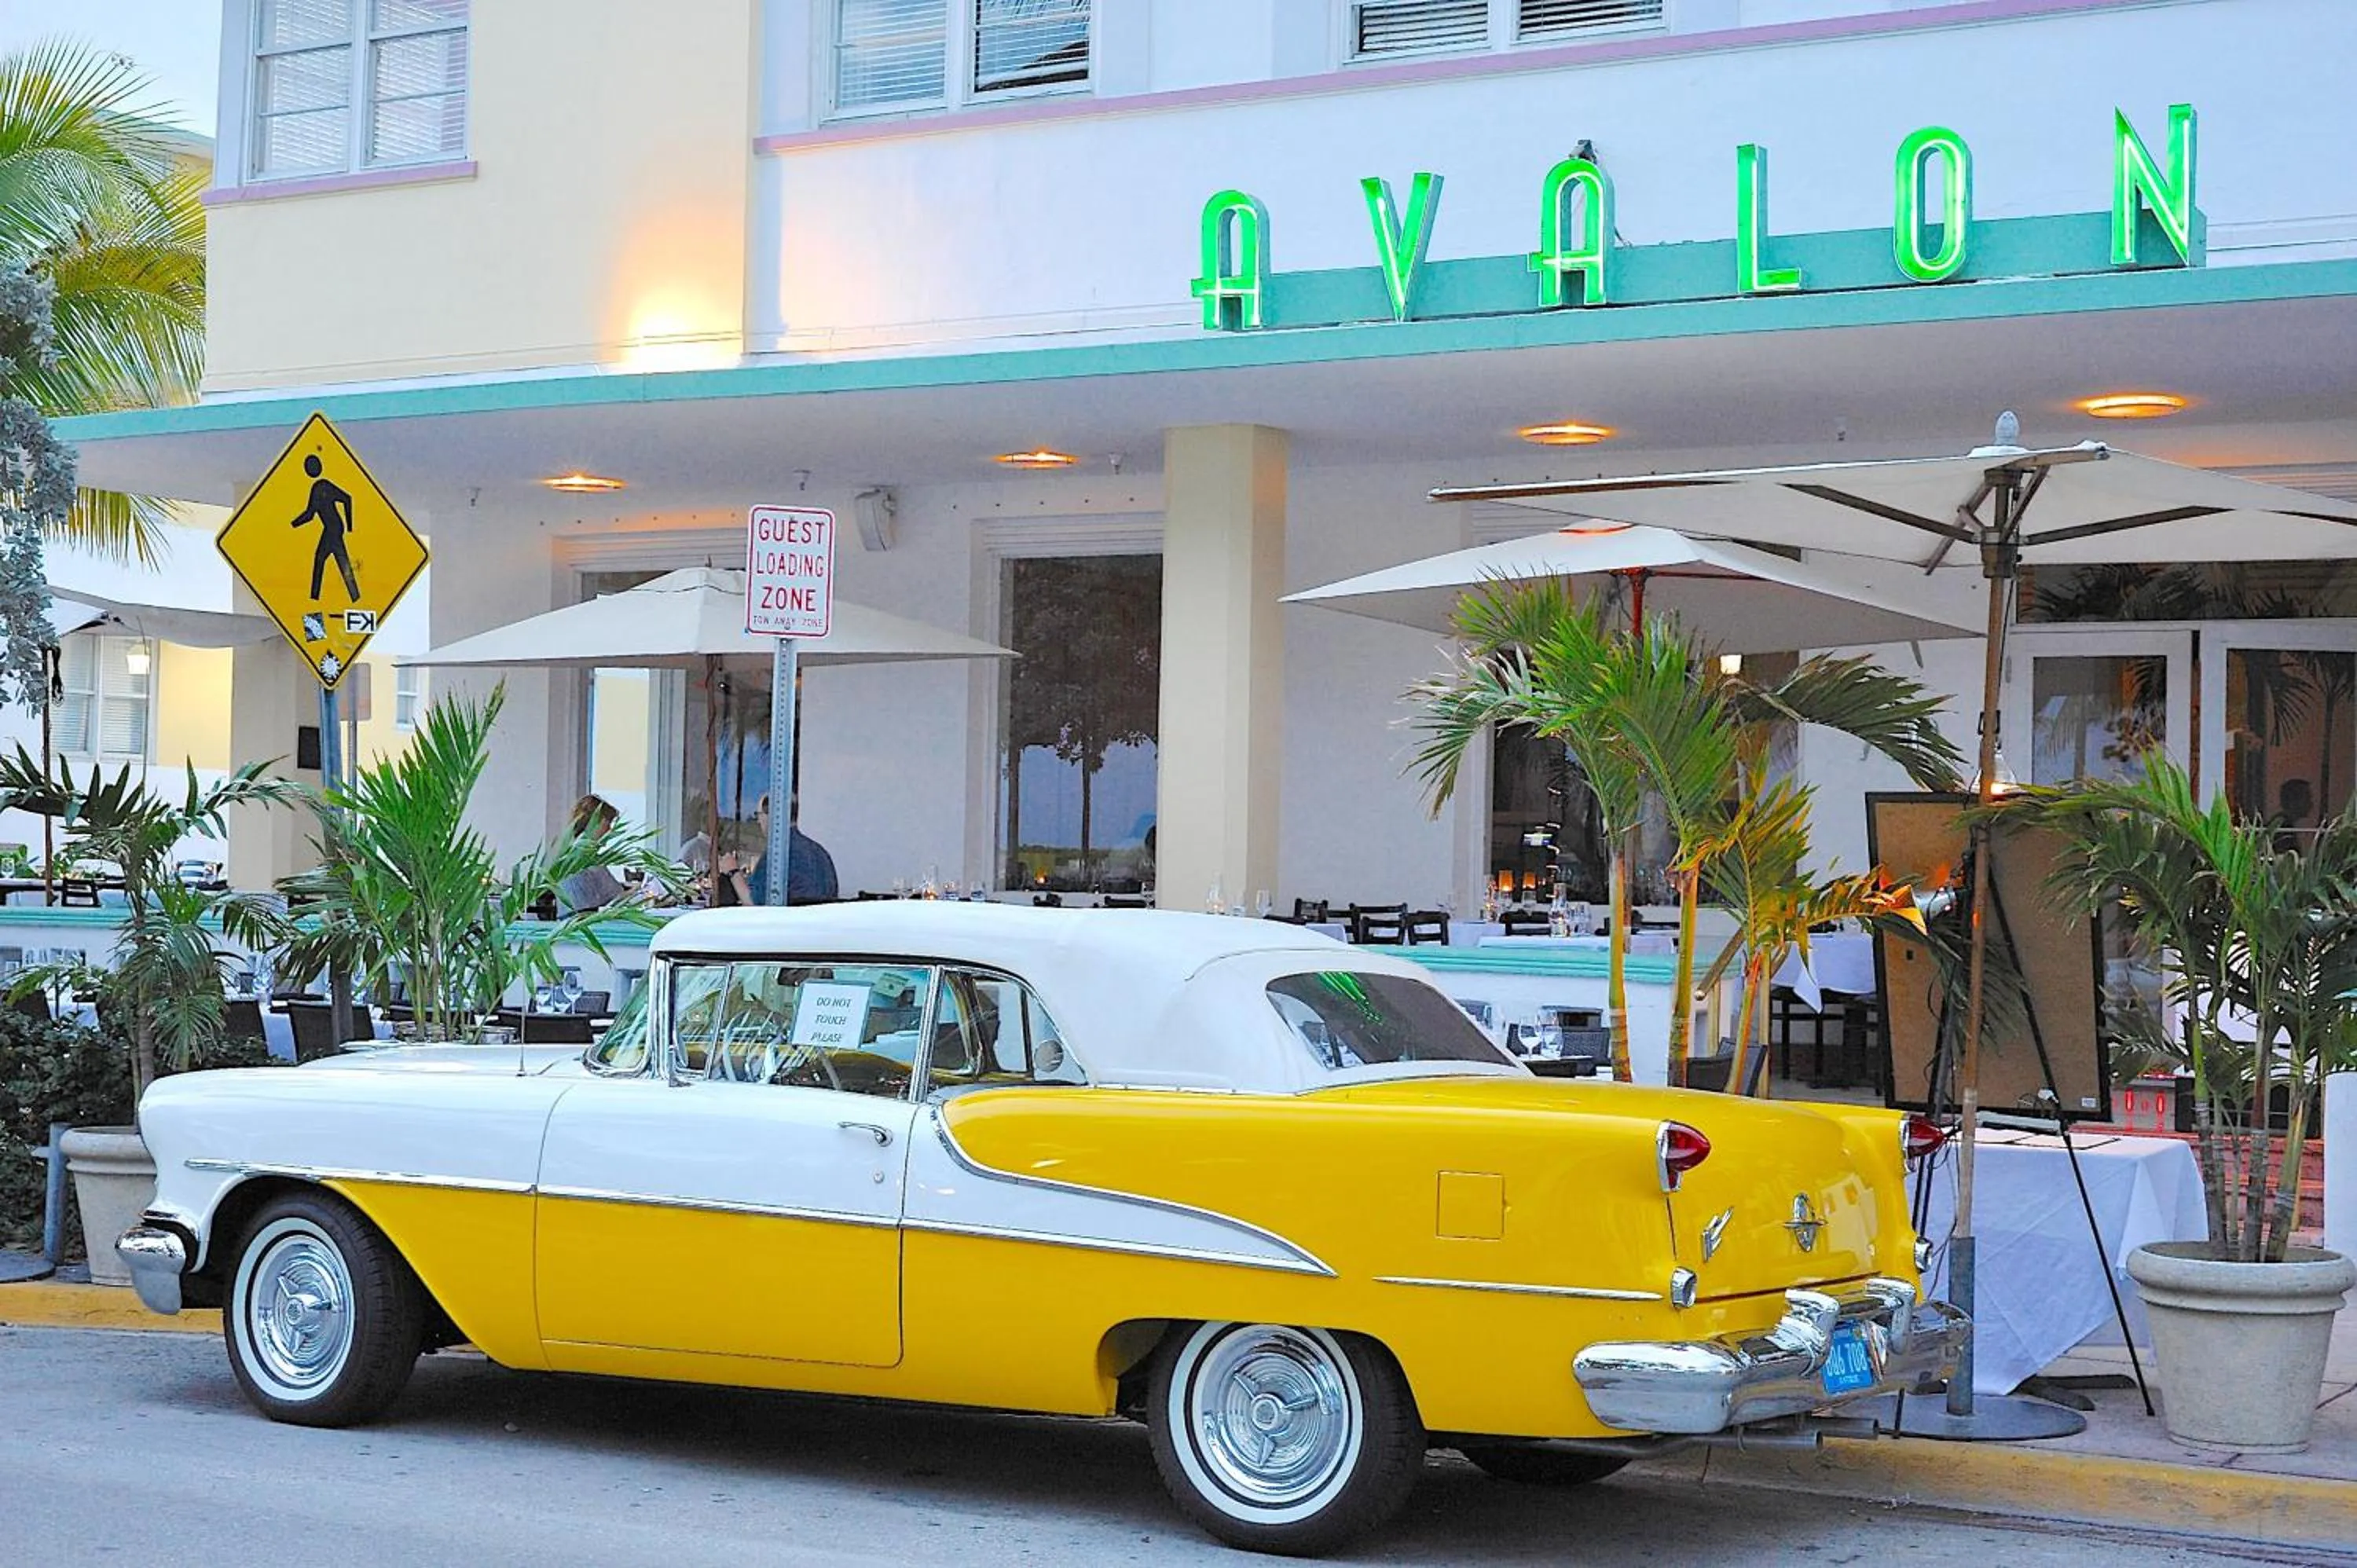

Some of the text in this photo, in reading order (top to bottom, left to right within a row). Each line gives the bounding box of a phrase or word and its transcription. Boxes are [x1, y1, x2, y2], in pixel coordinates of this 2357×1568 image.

[1191, 104, 2196, 330] AVALON
[758, 518, 825, 544] GUEST
[757, 551, 824, 577] LOADING
[761, 586, 816, 611] ZONE
[753, 615, 824, 628] TOW AWAY ZONE
[816, 997, 852, 1007] DO NOT
[815, 1014, 847, 1025] TOUCH
[810, 1031, 842, 1042] PLEASE
